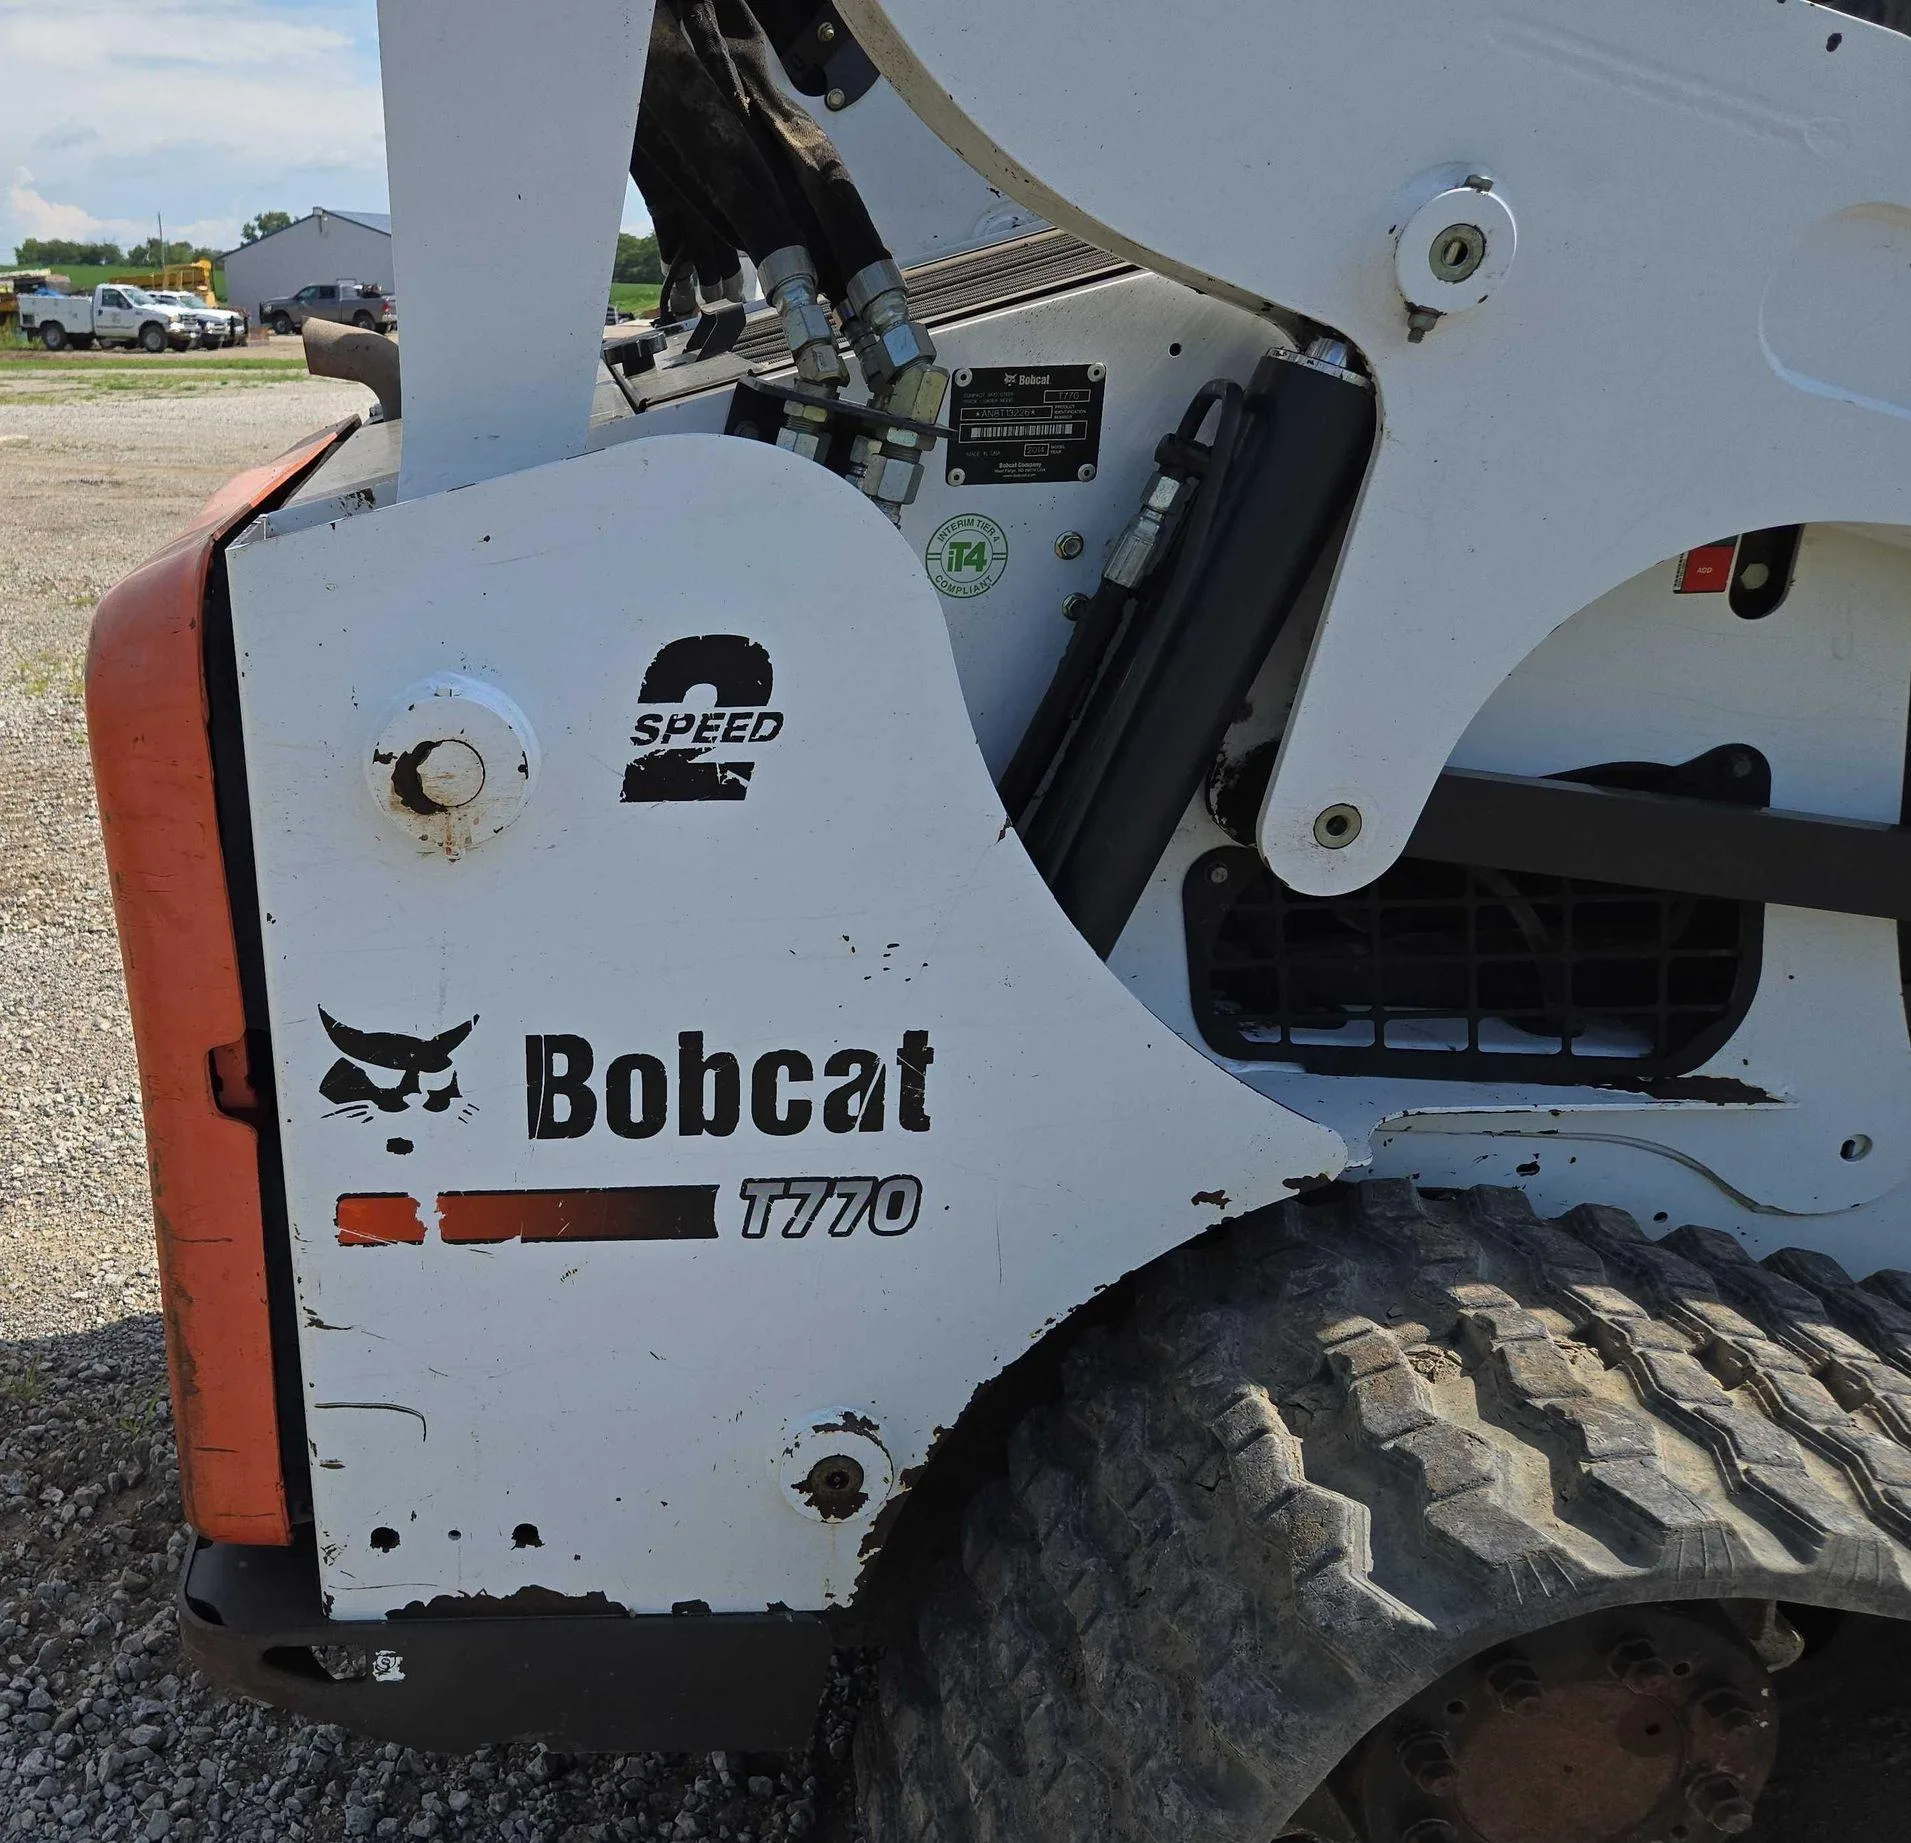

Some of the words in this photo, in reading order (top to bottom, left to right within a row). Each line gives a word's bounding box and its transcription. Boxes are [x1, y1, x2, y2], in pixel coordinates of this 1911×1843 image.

[1019, 374, 1050, 386] Bobcat
[1058, 391, 1080, 400] T770
[937, 518, 975, 542] INTERIM
[976, 519, 997, 537] TIER
[947, 541, 988, 573] iT4
[1696, 566, 1713, 575] ADD
[935, 574, 993, 595] COMPLIANT
[620, 634, 774, 803] 2
[630, 711, 784, 747] SPEED
[525, 1030, 935, 1140] Bobcat
[740, 1173, 923, 1240] T770
